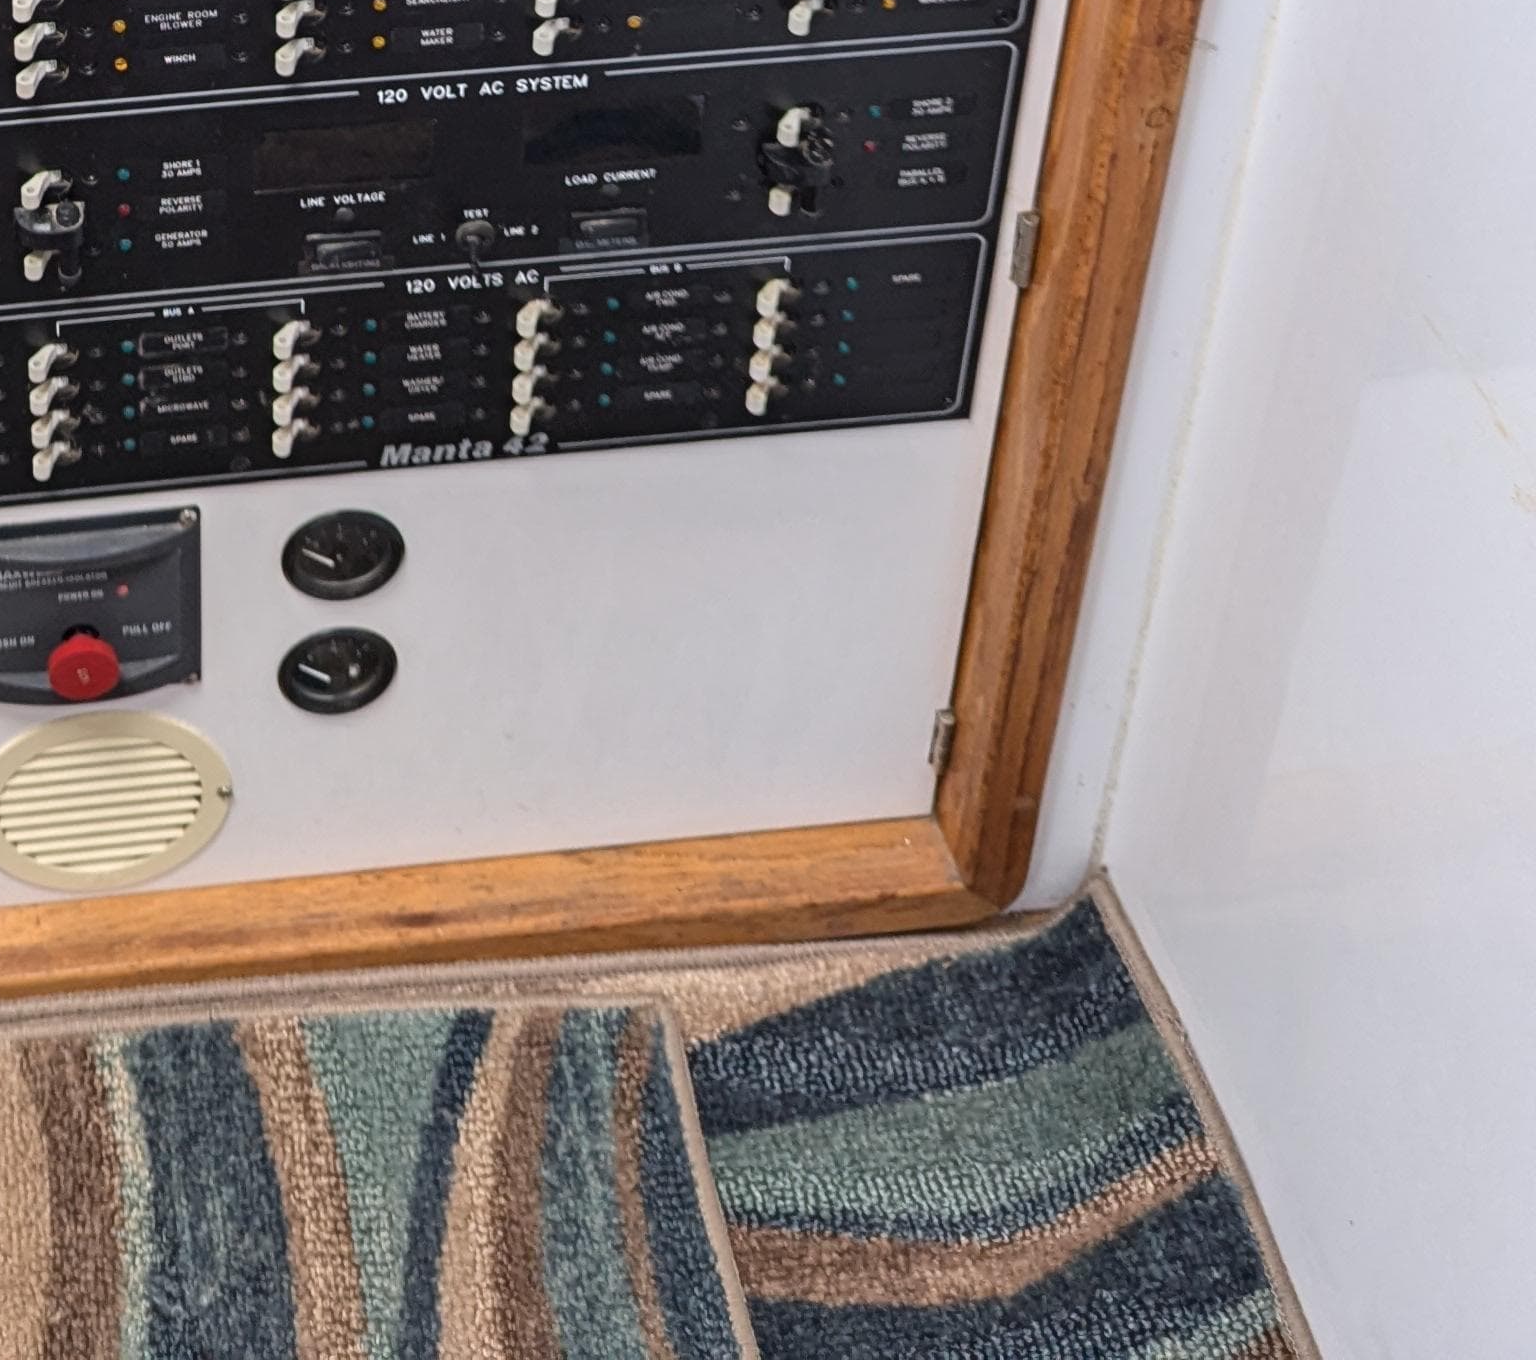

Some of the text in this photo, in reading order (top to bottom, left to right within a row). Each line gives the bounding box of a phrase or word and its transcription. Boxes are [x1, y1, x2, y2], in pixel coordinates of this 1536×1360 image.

[144, 9, 218, 24] ENGINE ROOM
[159, 19, 203, 31] BLOWER
[420, 27, 454, 37] WATER
[420, 36, 454, 46] MAKER
[164, 53, 196, 64] WINCH
[377, 74, 589, 105] 120 VOLT AC SYSTEM
[162, 160, 193, 170] SHORE
[176, 167, 202, 177] AMPS
[565, 168, 657, 187] LOAD CURRENT
[160, 195, 202, 206] REVERSE
[300, 191, 386, 209] LINE VOLTAGE
[159, 203, 204, 215] POLARITY
[463, 208, 489, 219] TEST
[154, 229, 208, 242] GENERATOR
[503, 225, 525, 237] LINE
[176, 238, 202, 247] AMPS
[412, 234, 435, 245] LINE
[405, 268, 541, 295] 120 VOLTS AC
[380, 431, 550, 467] Manta 42
[122, 621, 173, 637] PULL OFF
[20, 635, 35, 647] ON
